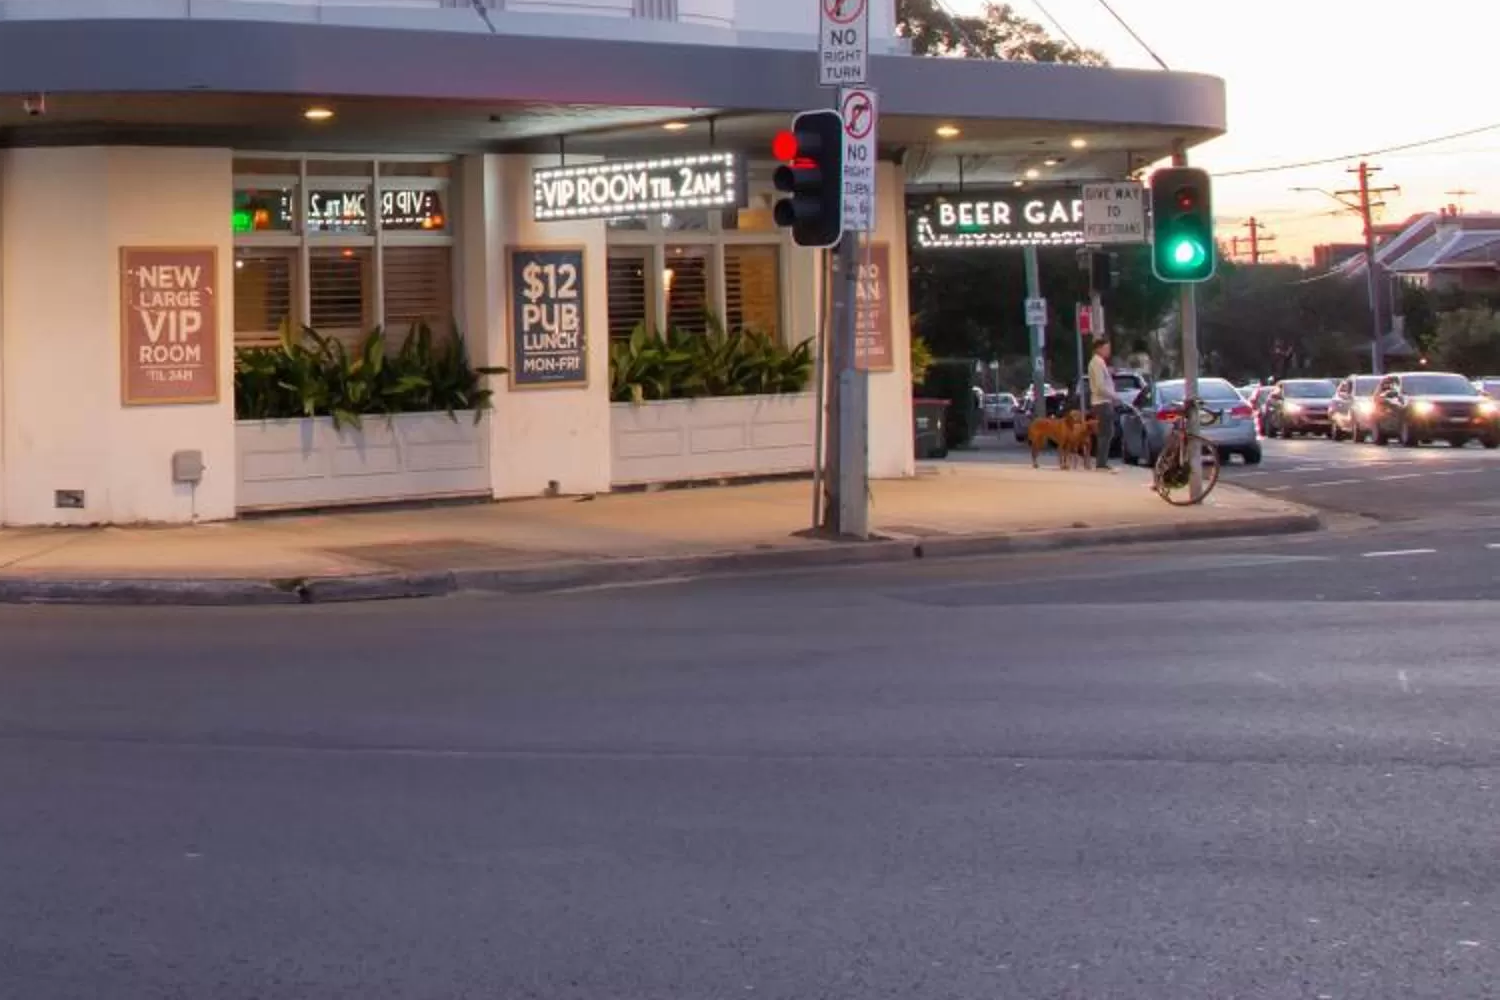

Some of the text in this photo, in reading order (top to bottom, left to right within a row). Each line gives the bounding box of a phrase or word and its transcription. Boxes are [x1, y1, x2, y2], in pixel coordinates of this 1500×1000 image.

[831, 29, 856, 46] NO
[824, 50, 862, 63] RIGHT
[826, 66, 861, 79] TURN
[848, 144, 867, 161] NO
[543, 167, 721, 207] VIP ROOM TIL 2AM
[1115, 187, 1139, 201] WAY
[939, 201, 1011, 226] BEER
[139, 265, 201, 288] NEW
[522, 262, 577, 302] $12
[140, 291, 201, 307] LARGE
[141, 311, 202, 343] VIP
[523, 304, 579, 332] PUB
[523, 332, 578, 350] LUNCH
[139, 344, 201, 363] ROOM
[524, 356, 580, 372] MON-FRI
